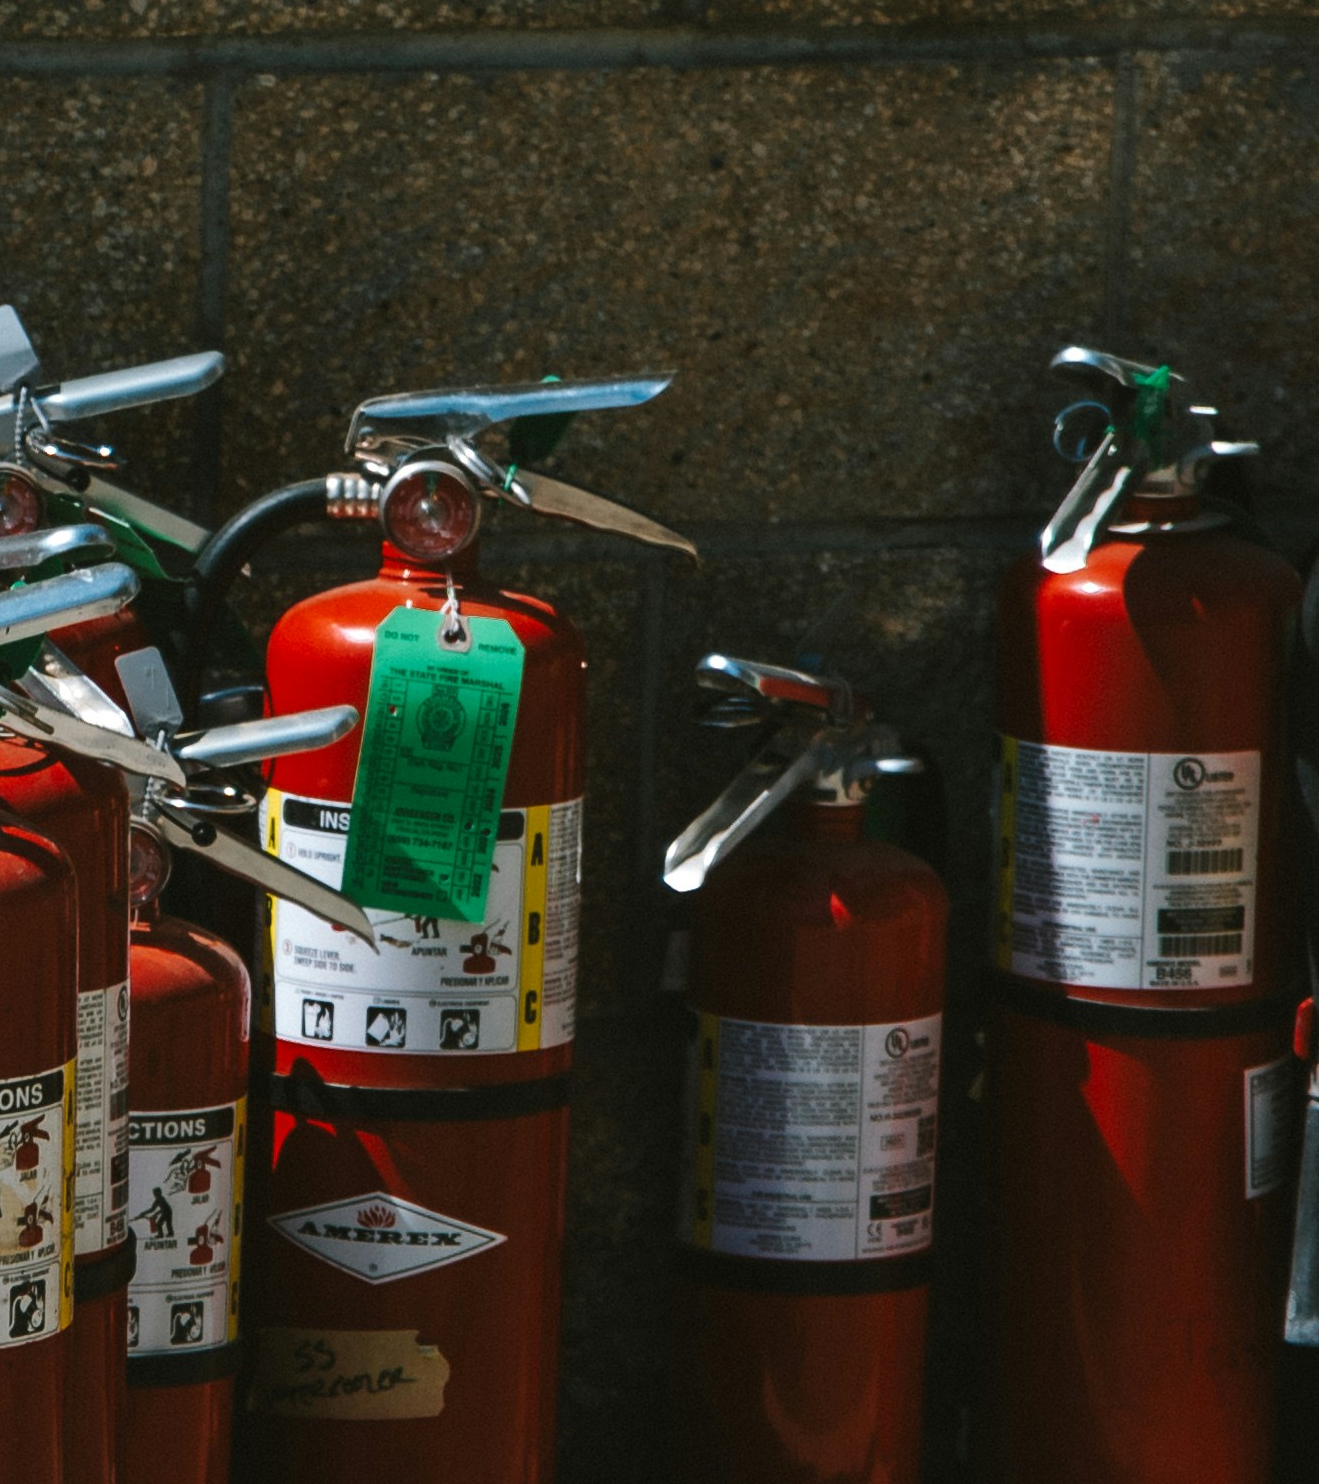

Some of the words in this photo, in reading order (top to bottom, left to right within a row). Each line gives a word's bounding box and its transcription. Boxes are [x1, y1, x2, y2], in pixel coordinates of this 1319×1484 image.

[479, 643, 516, 655] REMOVE
[409, 669, 437, 681] STATE
[461, 676, 505, 690] MARSHAL
[531, 833, 543, 866] A
[528, 912, 540, 945] B
[524, 990, 537, 1024] C
[298, 1220, 462, 1246] AMEREX
